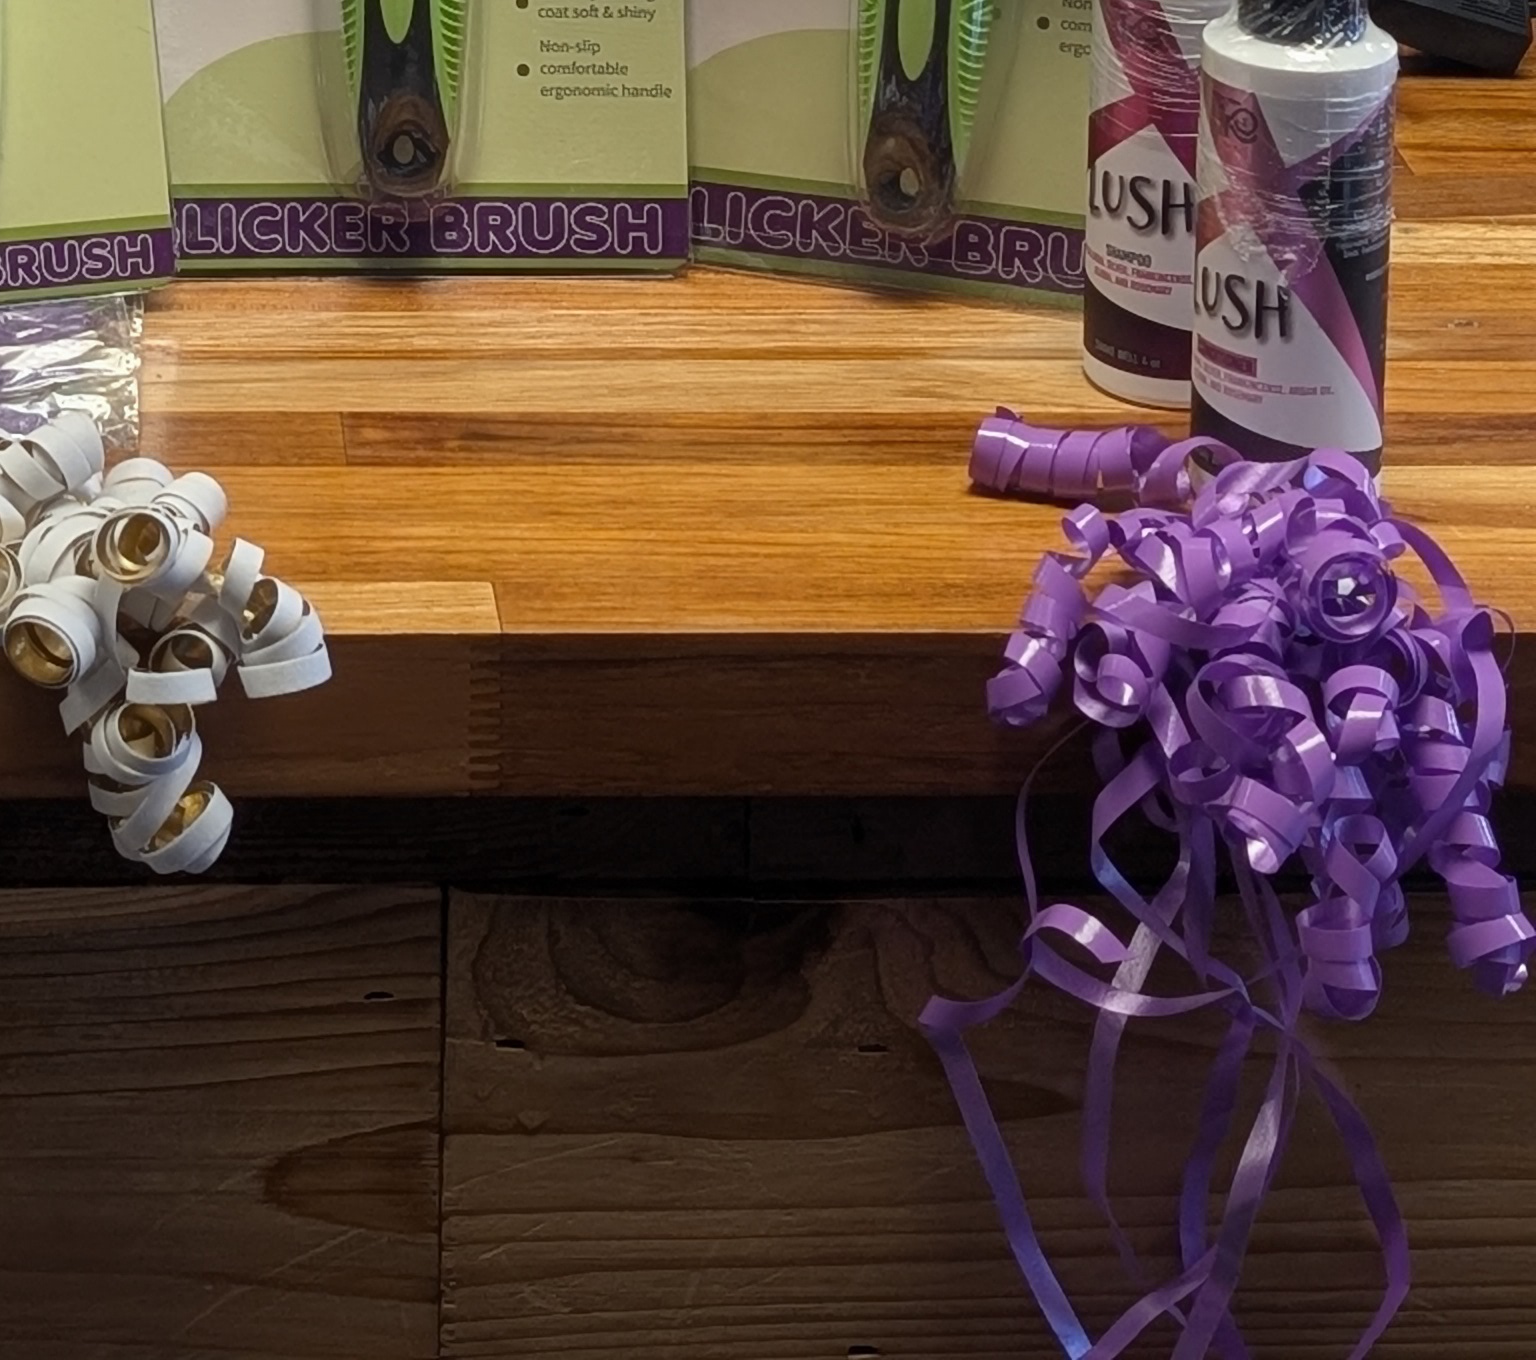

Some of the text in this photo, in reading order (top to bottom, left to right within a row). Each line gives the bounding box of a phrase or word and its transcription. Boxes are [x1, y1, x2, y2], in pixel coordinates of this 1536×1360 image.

[538, 5, 656, 22] coat soft & shiny
[540, 40, 600, 55] Non-slip
[540, 61, 629, 76] comfortable
[540, 84, 672, 100] ergonomic handle
[1088, 165, 1194, 235] LUSH
[178, 201, 664, 255] LICKER BRUSH
[690, 186, 1086, 289] LICKER BRU
